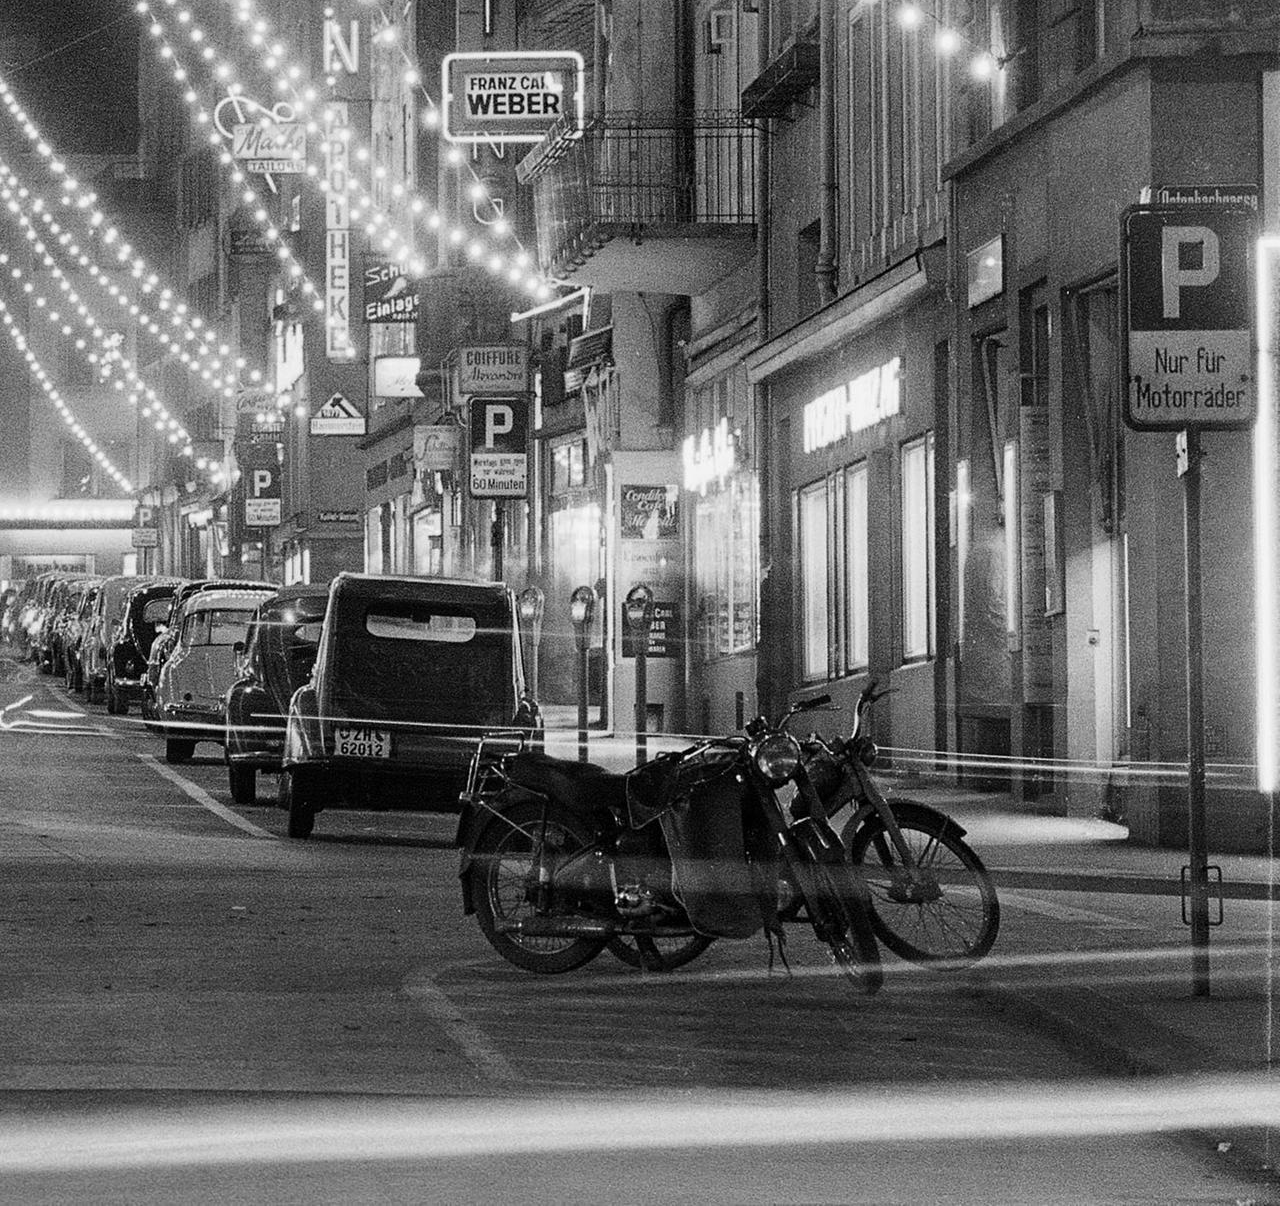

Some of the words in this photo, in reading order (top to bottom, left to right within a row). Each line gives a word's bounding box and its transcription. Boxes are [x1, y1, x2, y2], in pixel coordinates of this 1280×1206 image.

[470, 77, 517, 91] FRANZ
[467, 93, 560, 115] WEBER
[329, 107, 349, 352] APOTHEKE
[1162, 226, 1219, 318] P
[1155, 347, 1188, 374] Nur
[1197, 347, 1226, 374] für
[1136, 382, 1246, 409] Motorräder
[485, 404, 513, 448] P
[254, 470, 271, 496] P
[472, 478, 486, 491] 60
[487, 478, 525, 491] Minuten
[353, 728, 372, 742] ZH
[340, 742, 383, 757] 62012
